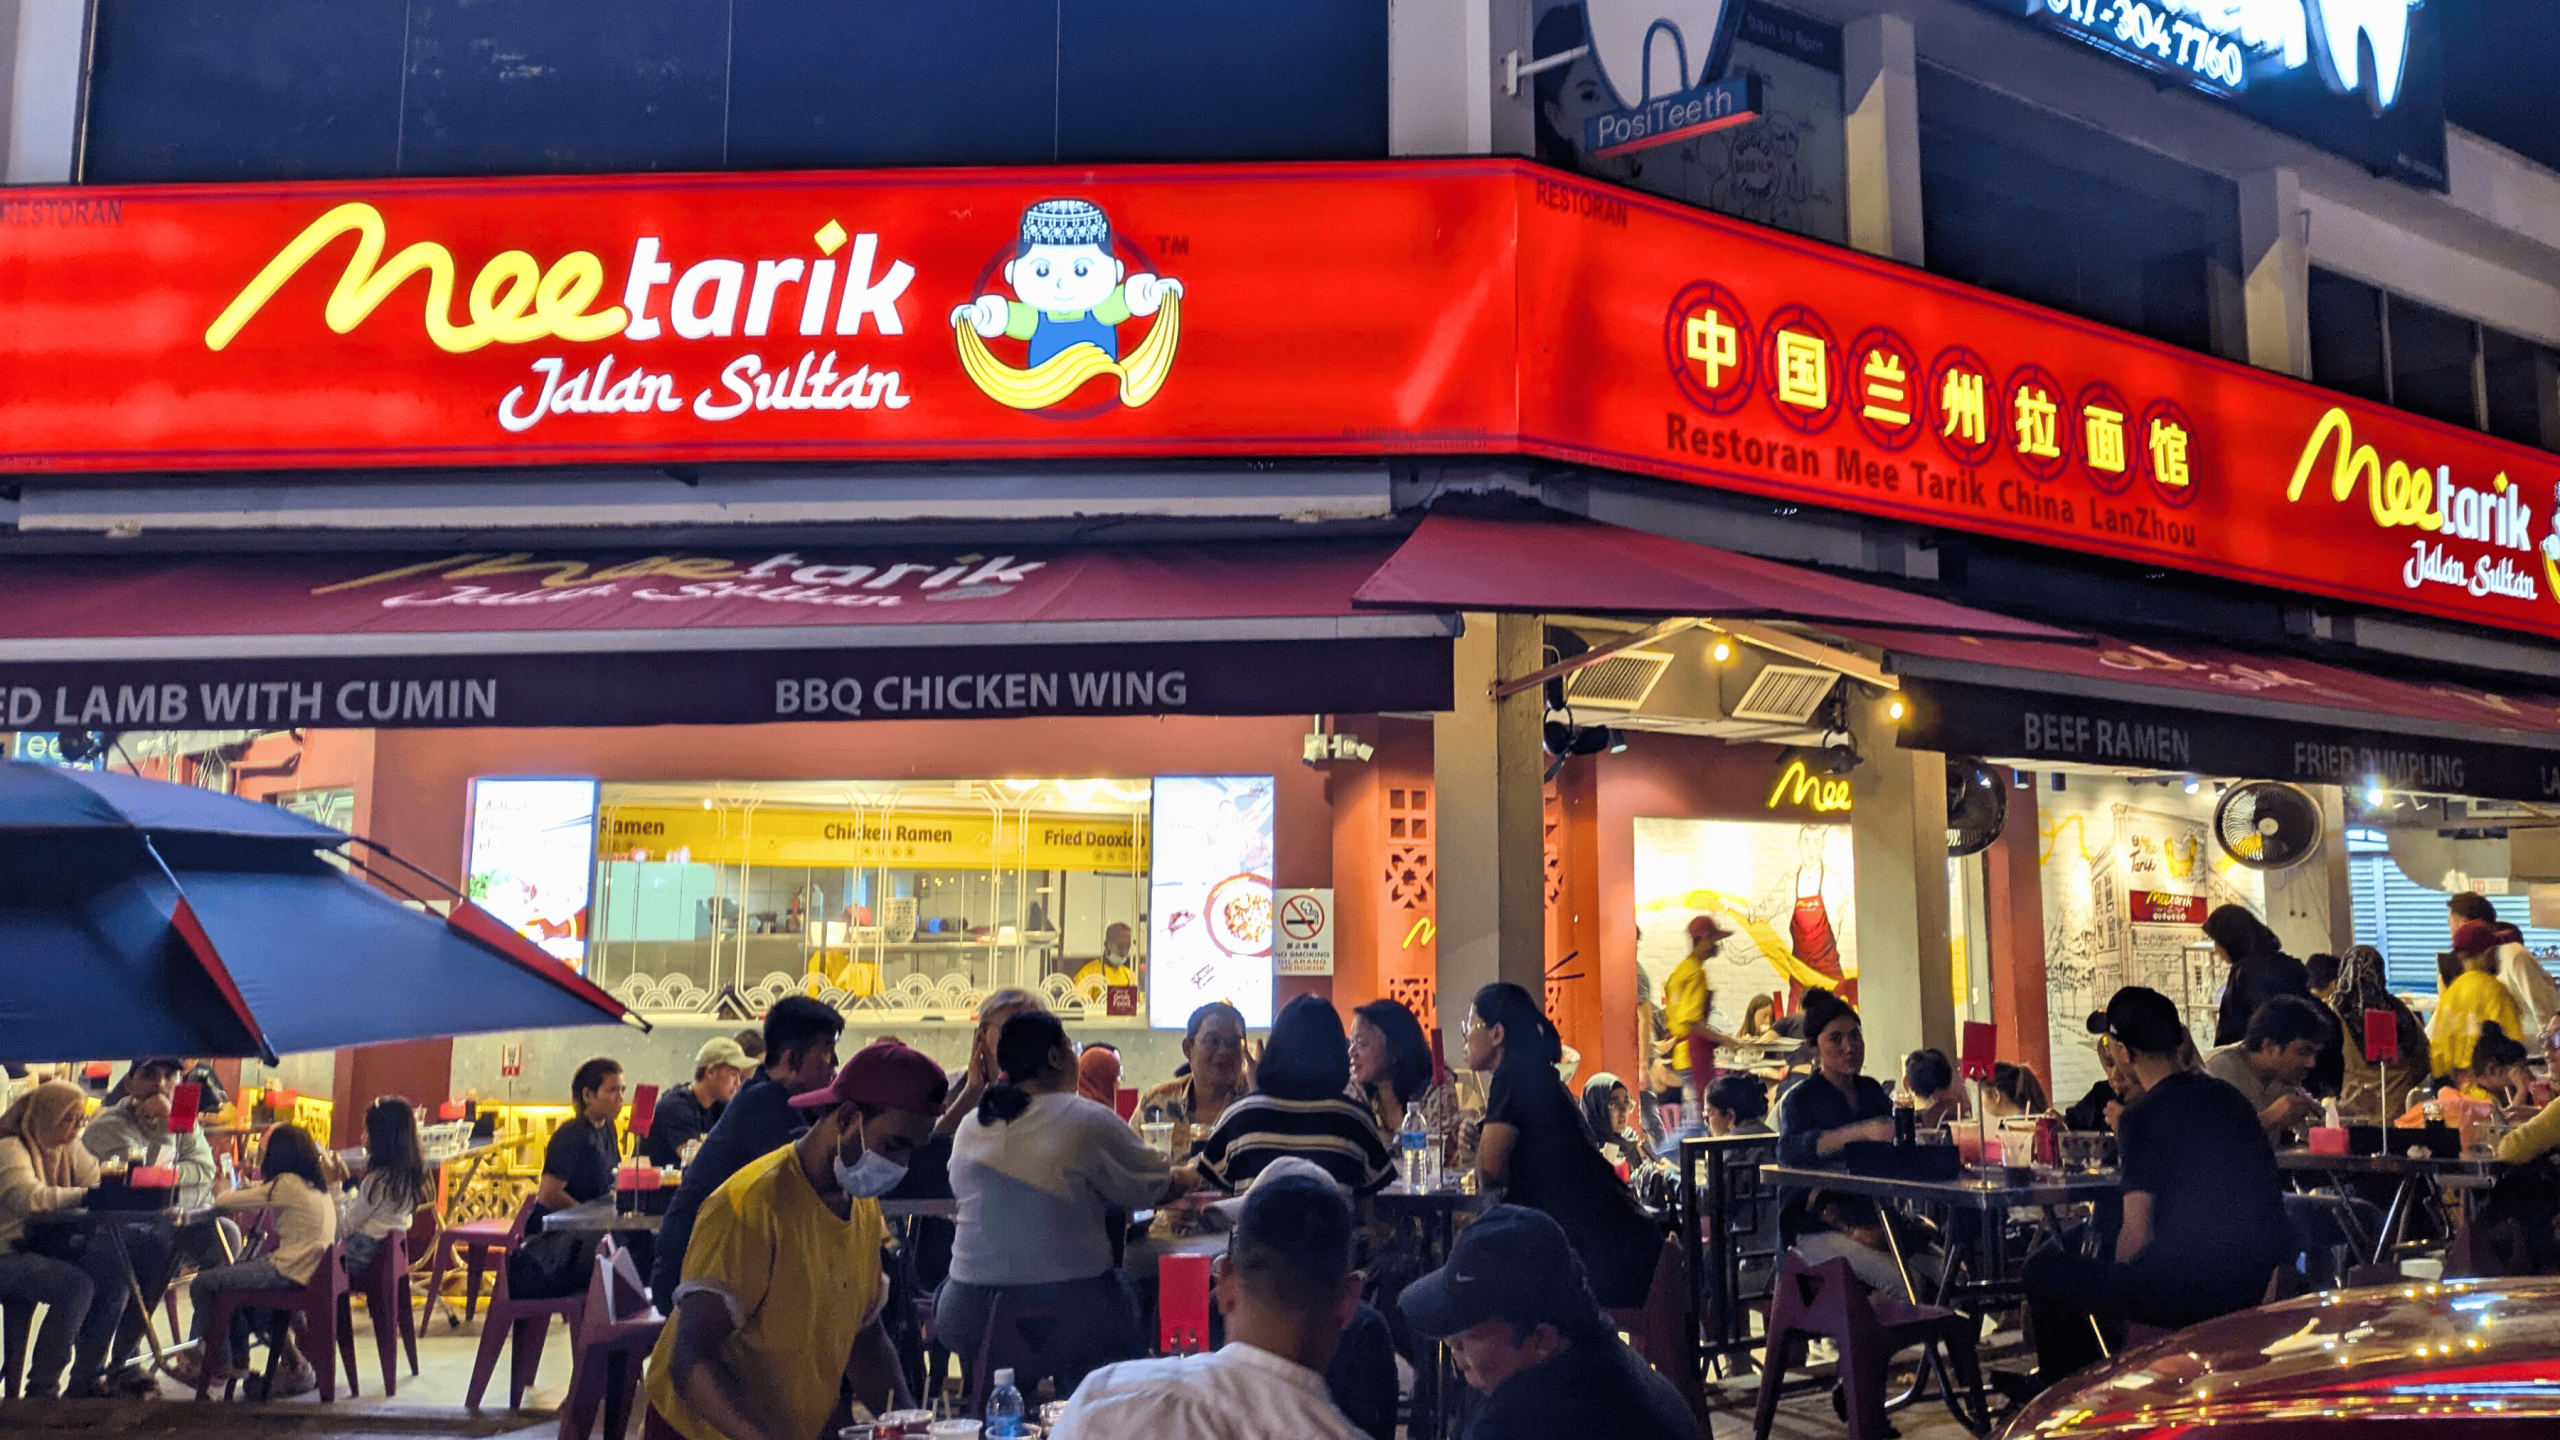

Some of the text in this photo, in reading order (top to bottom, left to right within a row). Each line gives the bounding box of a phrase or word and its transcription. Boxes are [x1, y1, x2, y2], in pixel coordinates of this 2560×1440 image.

[1536, 179, 1627, 228] RESTORAN
[1156, 235, 1189, 255] TM
[499, 350, 911, 433] Jalan Sultan
[1687, 308, 2190, 488] 中国兰州拉面馆
[1666, 411, 2196, 547] Restoran Mee Tarik China LanZhou
[2402, 540, 2538, 601] Jalan Sultan
[54, 683, 188, 725] LAMB
[200, 681, 323, 722] WITH
[336, 678, 497, 720] CUMIN
[775, 671, 1187, 716] BBQ CHICKEN WING
[2025, 712, 2190, 763] BEEF RAMEN
[2294, 741, 2353, 776] FRIED
[823, 822, 891, 842] Chicken
[896, 824, 953, 843] Ramen
[1044, 828, 1082, 846] Fried
